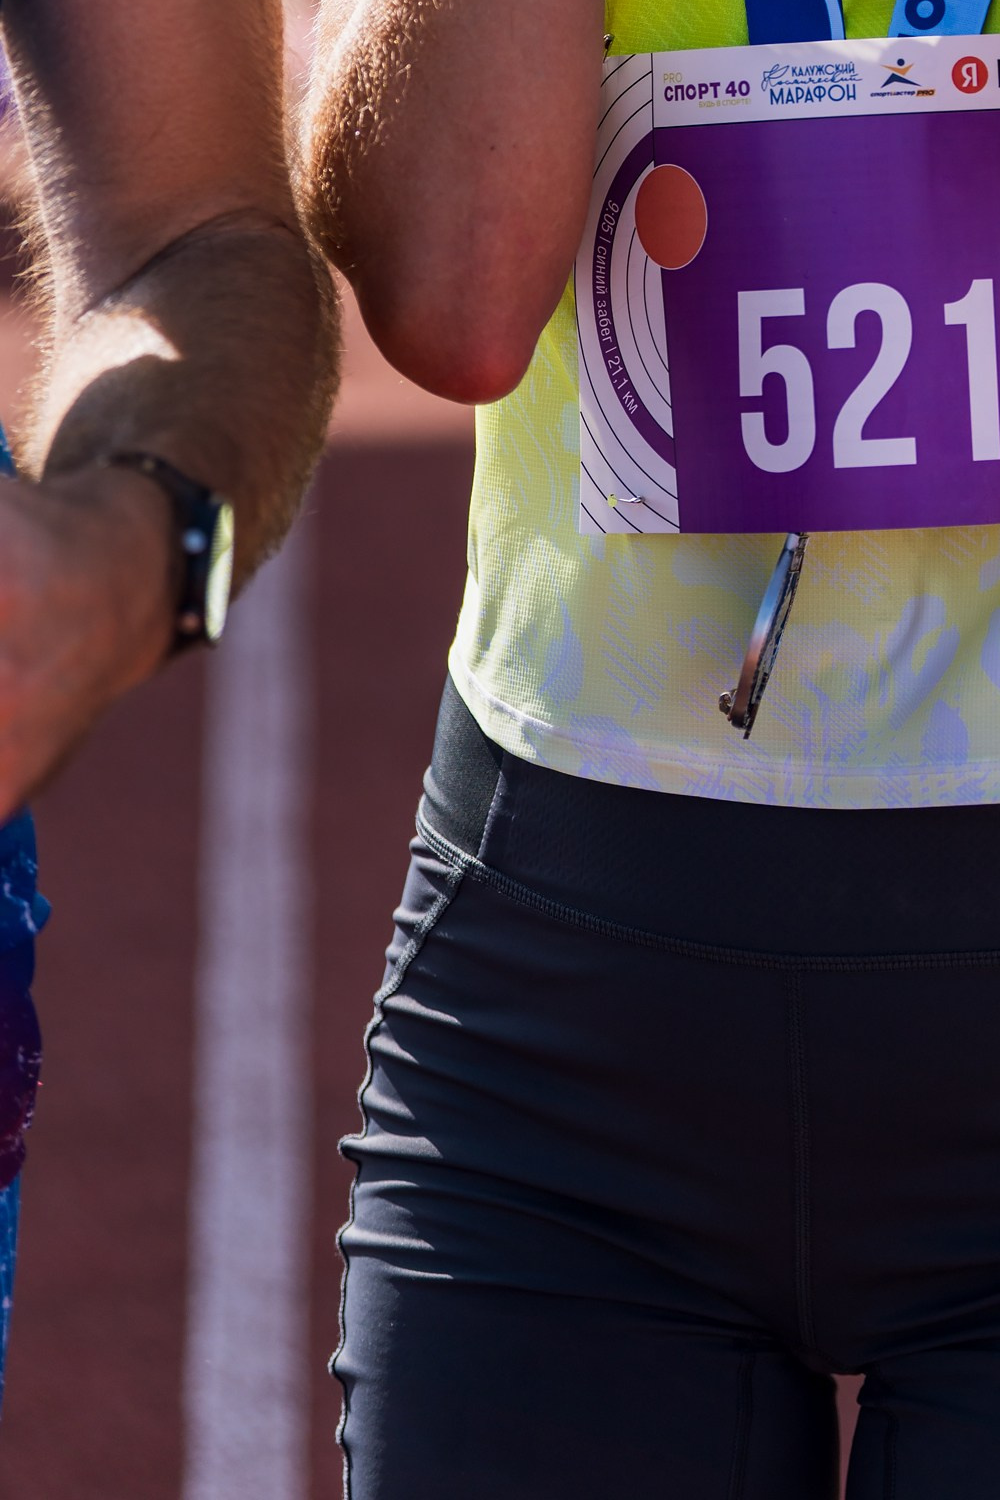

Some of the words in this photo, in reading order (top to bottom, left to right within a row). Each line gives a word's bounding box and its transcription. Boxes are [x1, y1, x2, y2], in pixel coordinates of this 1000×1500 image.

[663, 72, 683, 83] PRO
[791, 61, 855, 77] КАЛУЖСКИЙ
[961, 63, 978, 88] Я
[664, 83, 721, 102] СПОРТ
[725, 80, 751, 97] 40
[769, 84, 856, 105] МАРАФОН
[916, 88, 935, 97] PRO
[601, 199, 620, 235] 9:05
[595, 245, 608, 295] синий
[597, 301, 613, 343] забег
[607, 355, 630, 390] 21,1
